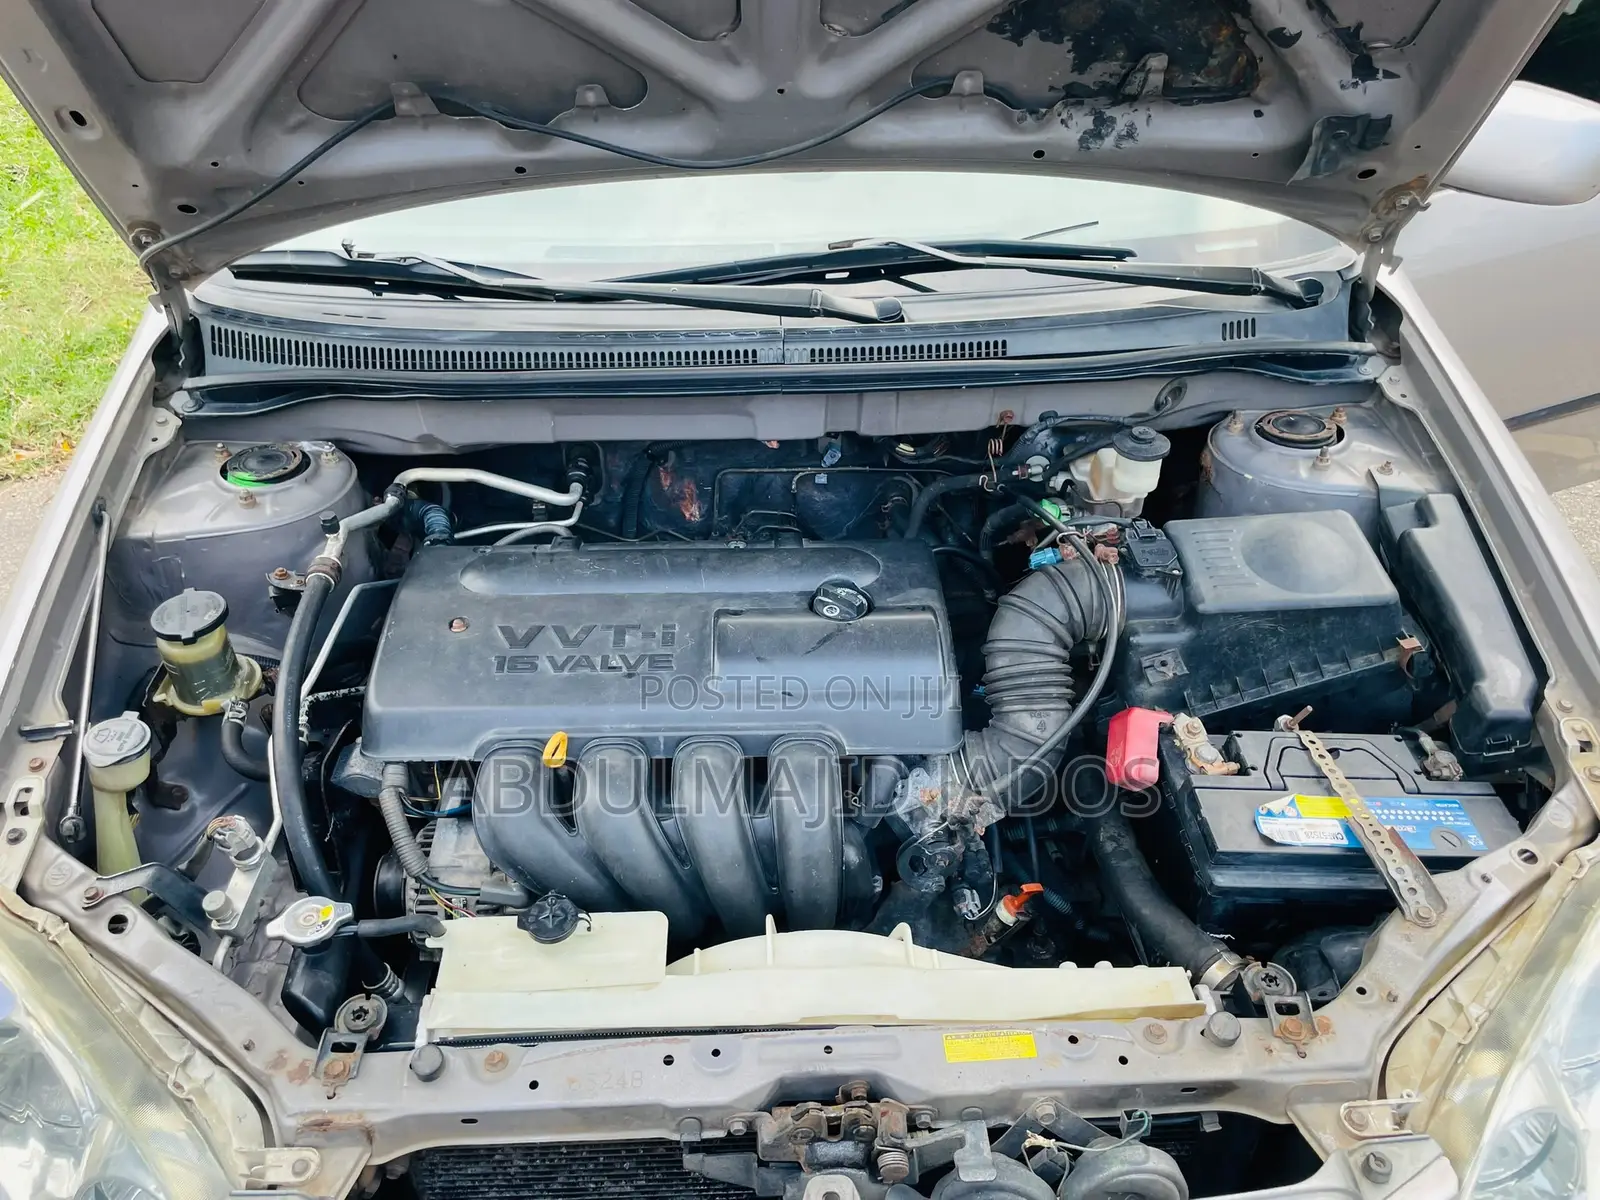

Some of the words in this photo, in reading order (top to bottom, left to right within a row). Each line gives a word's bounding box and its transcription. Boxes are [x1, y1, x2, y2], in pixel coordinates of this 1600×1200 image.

[497, 624, 677, 648] VVT-i
[493, 655, 539, 673] 16
[546, 654, 674, 673] VALVE
